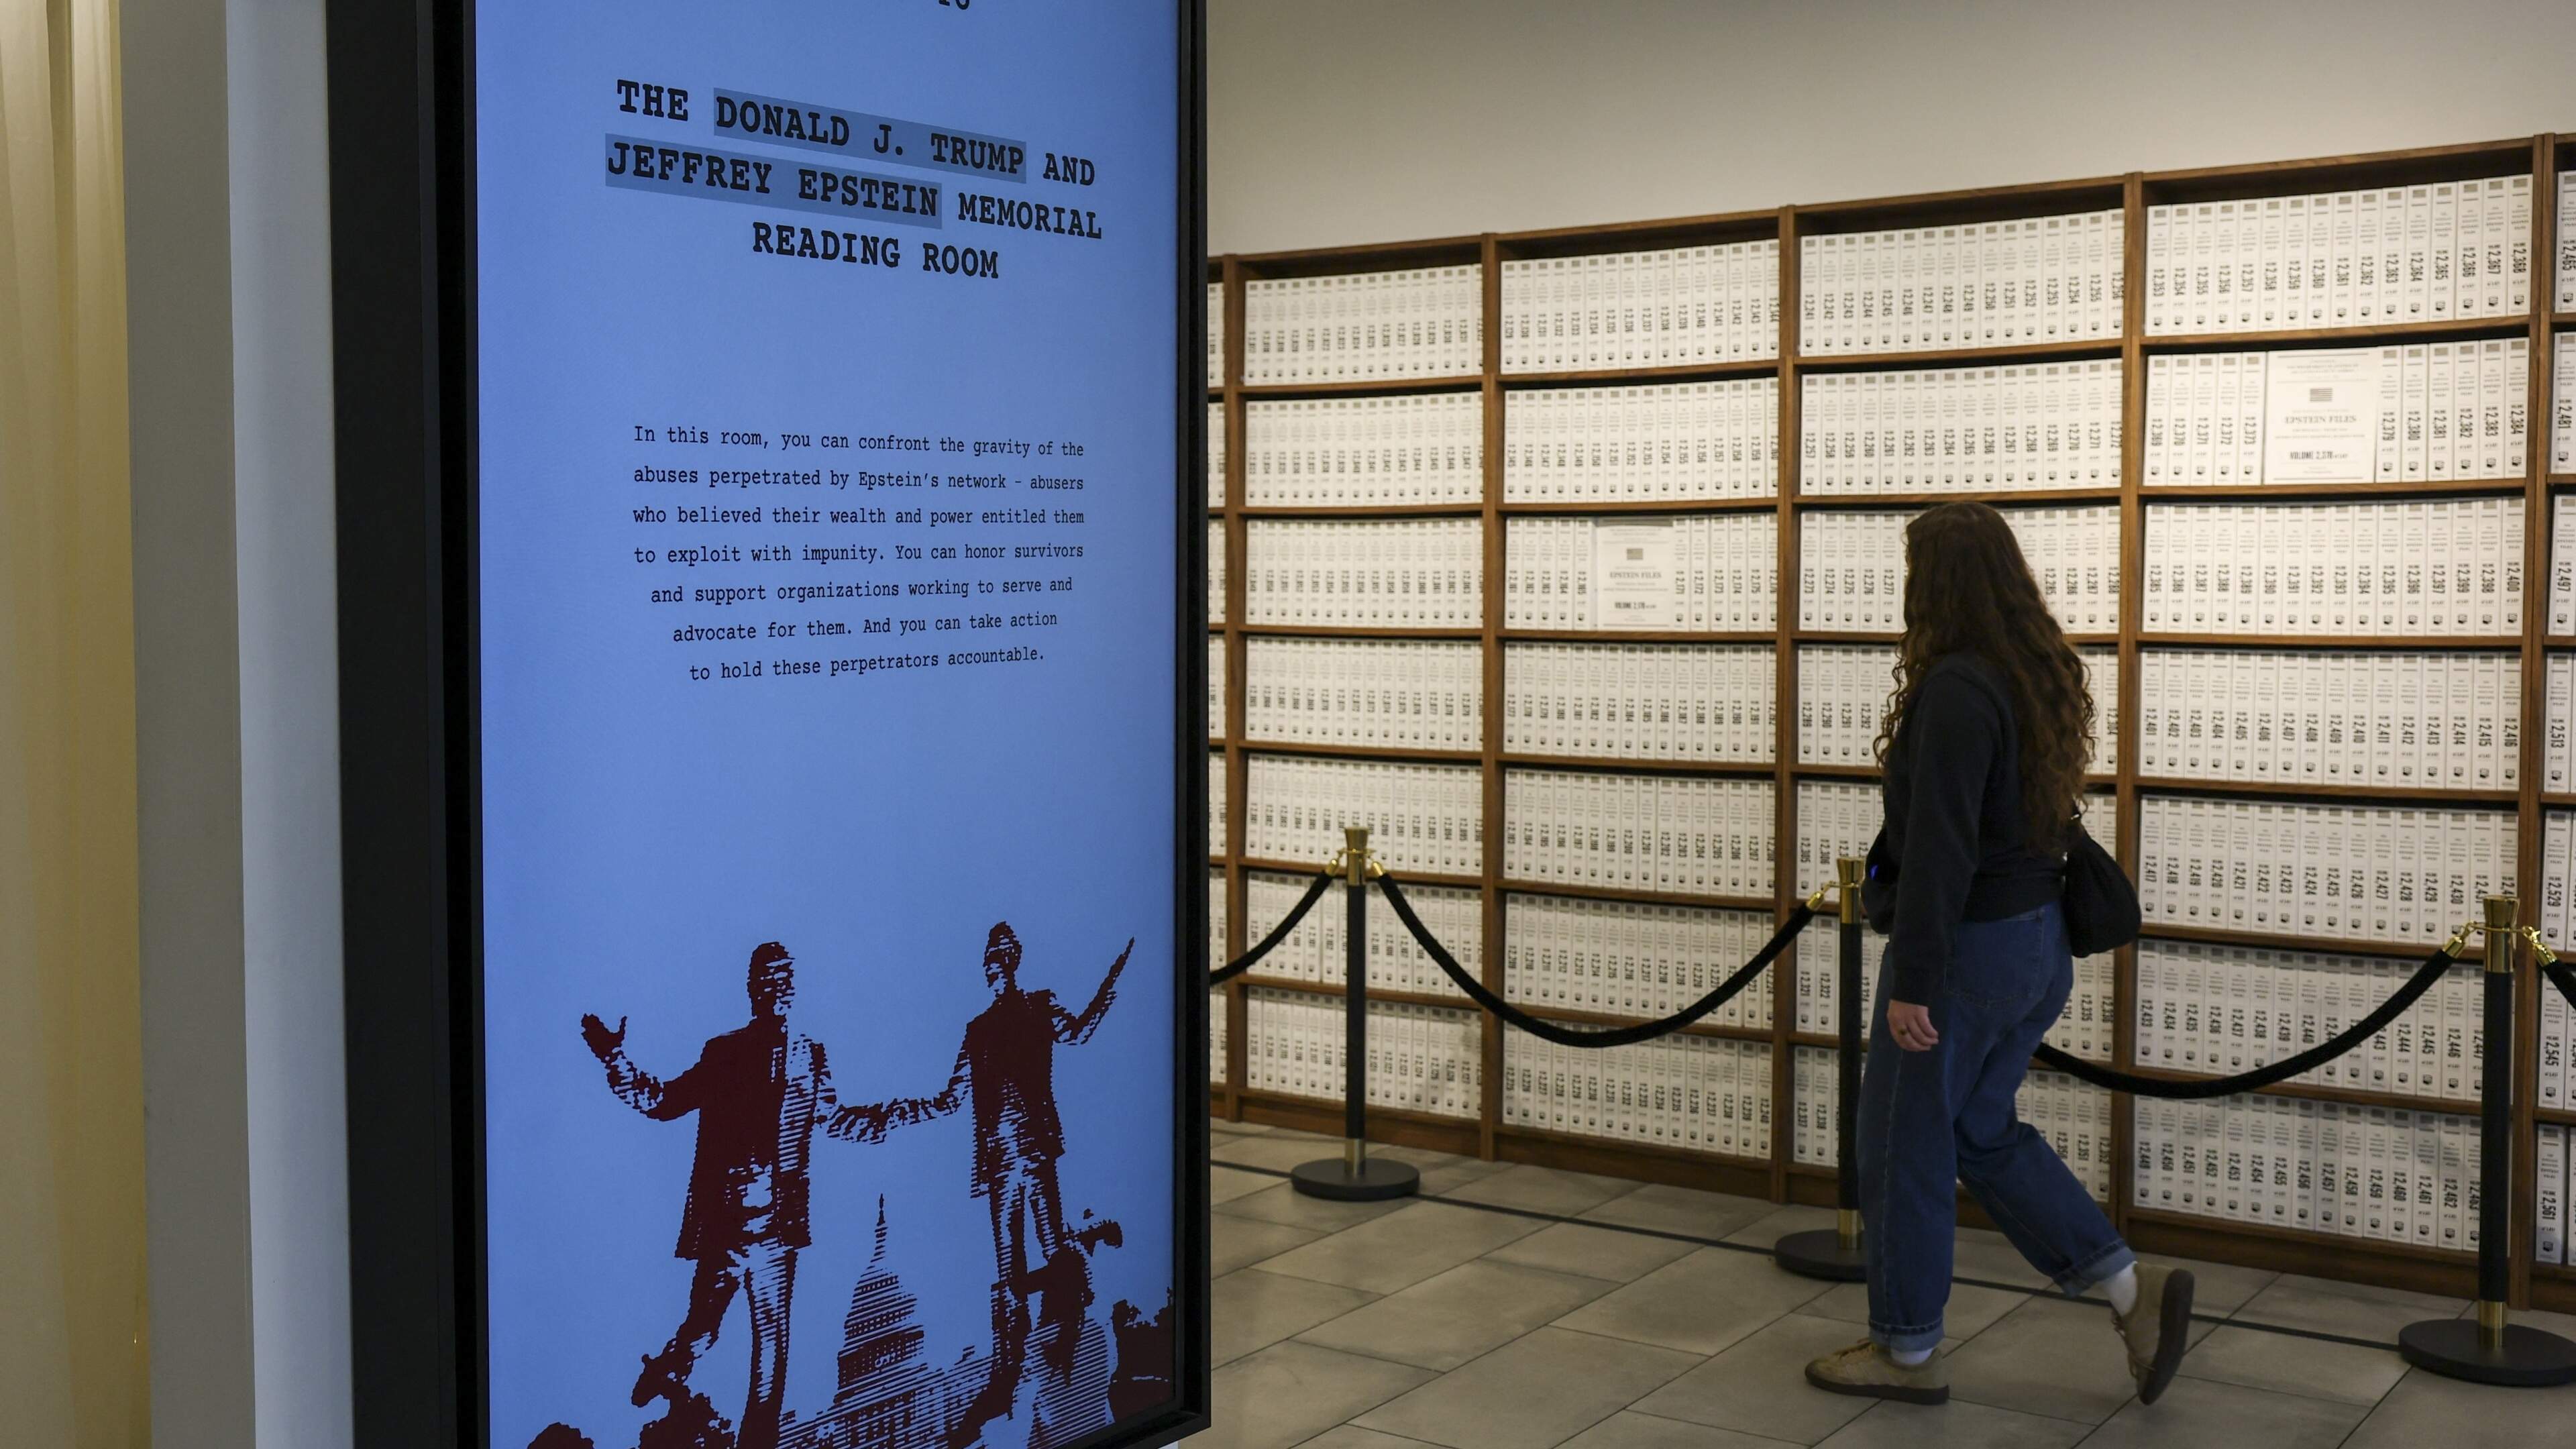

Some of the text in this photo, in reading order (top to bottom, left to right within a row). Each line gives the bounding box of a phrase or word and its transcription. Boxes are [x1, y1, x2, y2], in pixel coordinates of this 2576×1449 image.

[617, 79, 1095, 186] THE DONALD J. TRUMP AND
[608, 142, 1102, 239] JEFFREY EPSTEIN MEMORIAL
[753, 221, 999, 279] READING ROOM
[2561, 246, 2576, 271] 2,465
[2284, 415, 2357, 424] EPSTEIN FILES
[2557, 405, 2572, 429] 2,481
[634, 425, 1084, 459] In this room, you can confront the gravity of the
[633, 465, 698, 484] abuses
[708, 469, 822, 489] perpetrated
[829, 470, 850, 490] by
[947, 473, 1006, 489] network
[1030, 474, 1083, 490] abusers
[632, 505, 1085, 528] who believed their wealth and power entitled them
[633, 542, 1083, 567] to exploit with impunity. You can honor survivors
[651, 576, 1073, 606] and support organizations working to serve and
[2556, 568, 2572, 592] 2,497
[673, 610, 1058, 643] advocate for them. And you can take action
[689, 646, 1044, 681] to hold these perpetrators accountable.
[2551, 725, 2565, 749] 2,513
[2546, 881, 2562, 907] 2,529
[2544, 1041, 2560, 1067] 2,545
[2540, 1197, 2557, 1220] 2,561
